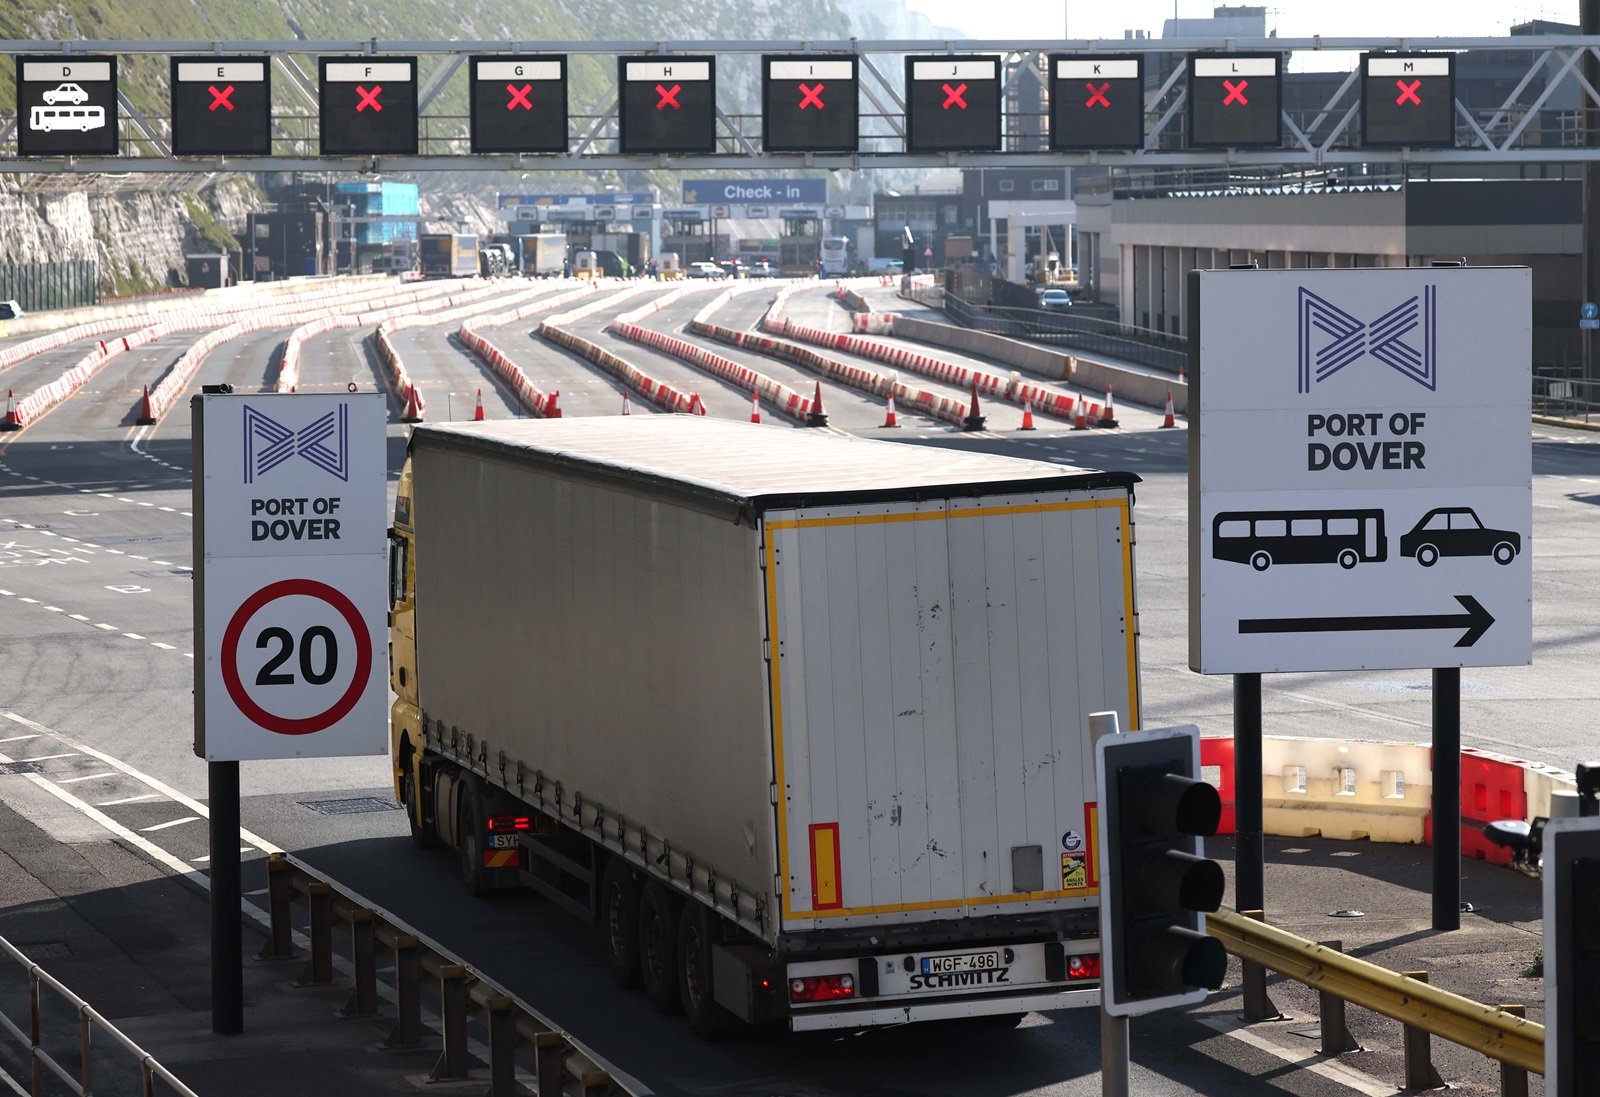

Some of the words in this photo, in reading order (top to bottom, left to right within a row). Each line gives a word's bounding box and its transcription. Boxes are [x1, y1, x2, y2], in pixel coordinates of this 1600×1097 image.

[62, 66, 71, 77] D
[217, 67, 225, 78] E
[364, 67, 372, 78] F
[514, 66, 523, 76] G
[663, 66, 672, 77] H
[809, 65, 813, 76] I
[951, 65, 958, 76] J
[1093, 65, 1102, 75] K
[1232, 62, 1239, 73] L
[1403, 61, 1414, 73] M
[724, 185, 772, 199] Check
[786, 184, 801, 198] in
[1308, 413, 1384, 437] PORT
[1388, 412, 1426, 436] OF
[1307, 441, 1426, 471] DOVER
[251, 497, 308, 516] PORT
[312, 496, 341, 515] OF
[251, 518, 341, 542] DOVER
[255, 625, 339, 686] 20
[932, 954, 994, 972] WGF-496
[910, 967, 1009, 990] SCHMITZ
